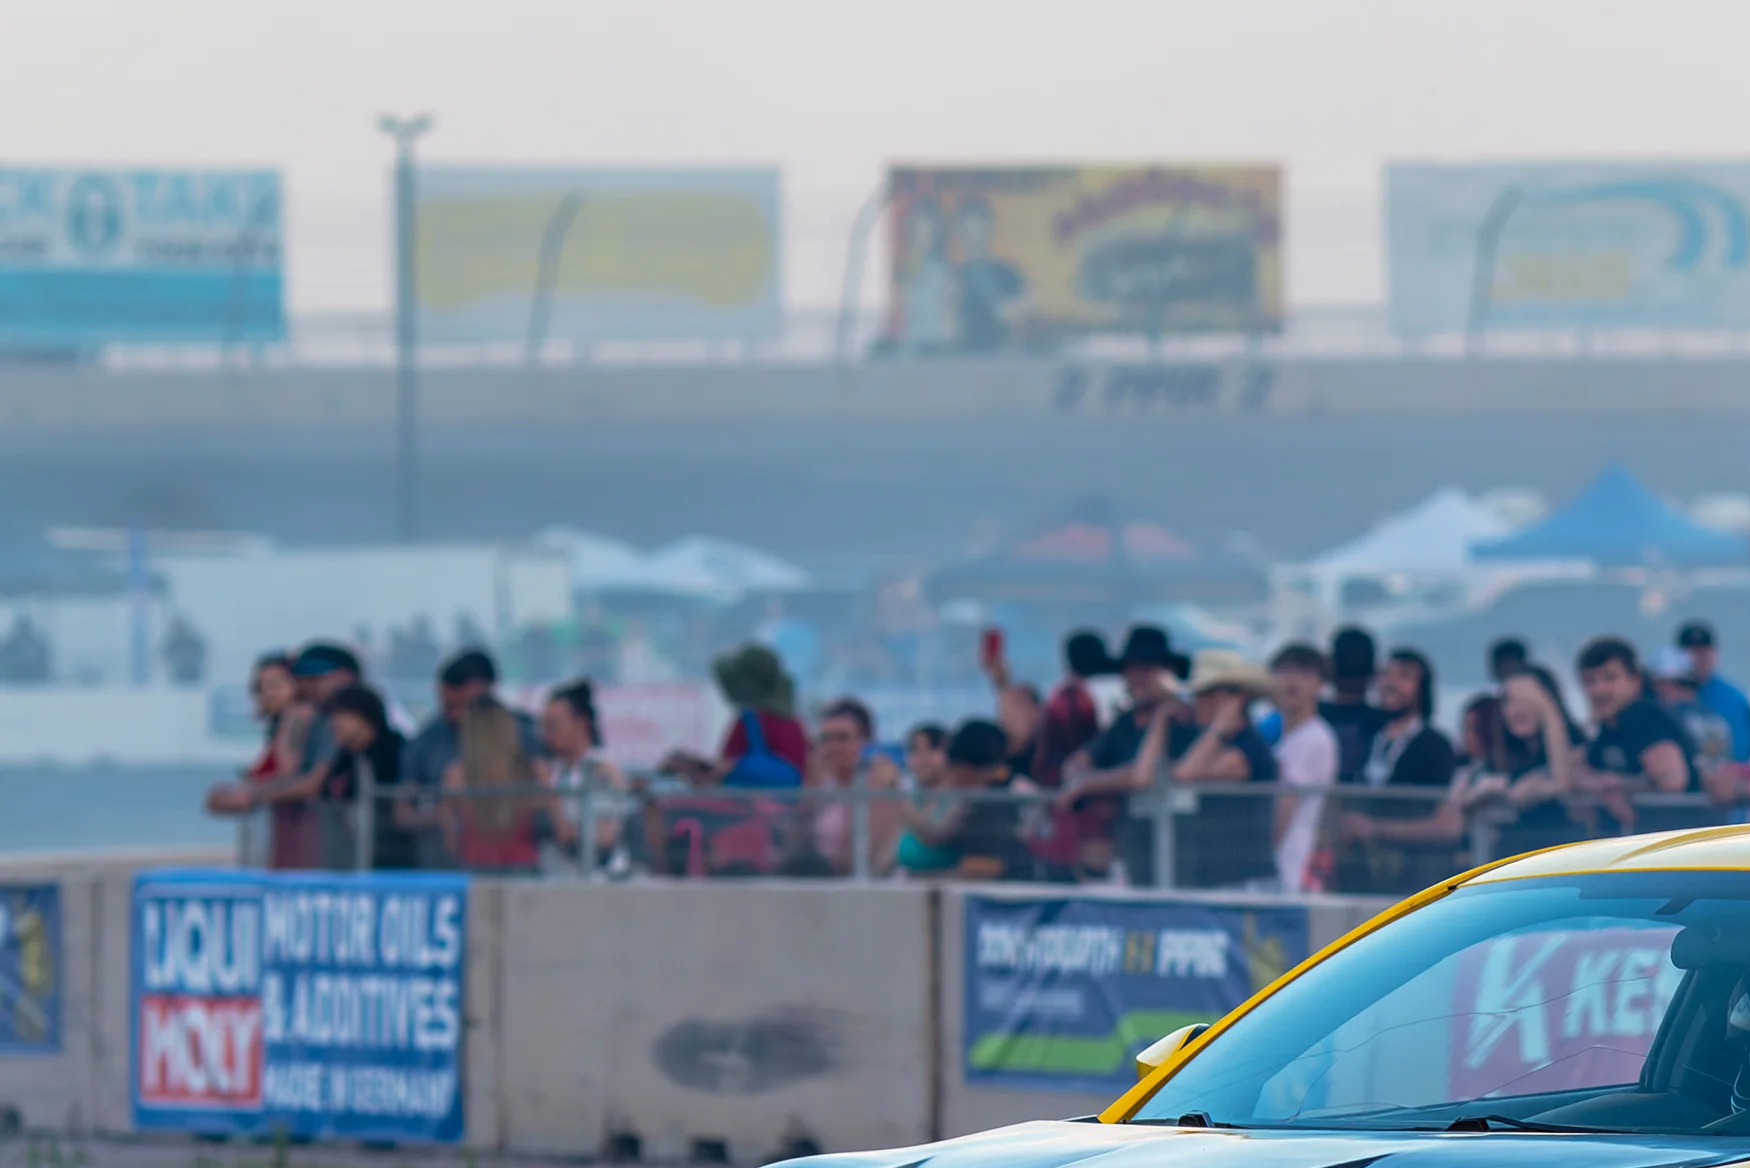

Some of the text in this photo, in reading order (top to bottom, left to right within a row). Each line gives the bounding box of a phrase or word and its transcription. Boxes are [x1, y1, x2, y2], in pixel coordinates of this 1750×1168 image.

[144, 898, 260, 990] LIQUI
[264, 893, 459, 970] MOTOR OILS
[142, 1003, 261, 1094] MOLY
[264, 971, 459, 1051] & ADDITIVES
[264, 1062, 321, 1111] MADE
